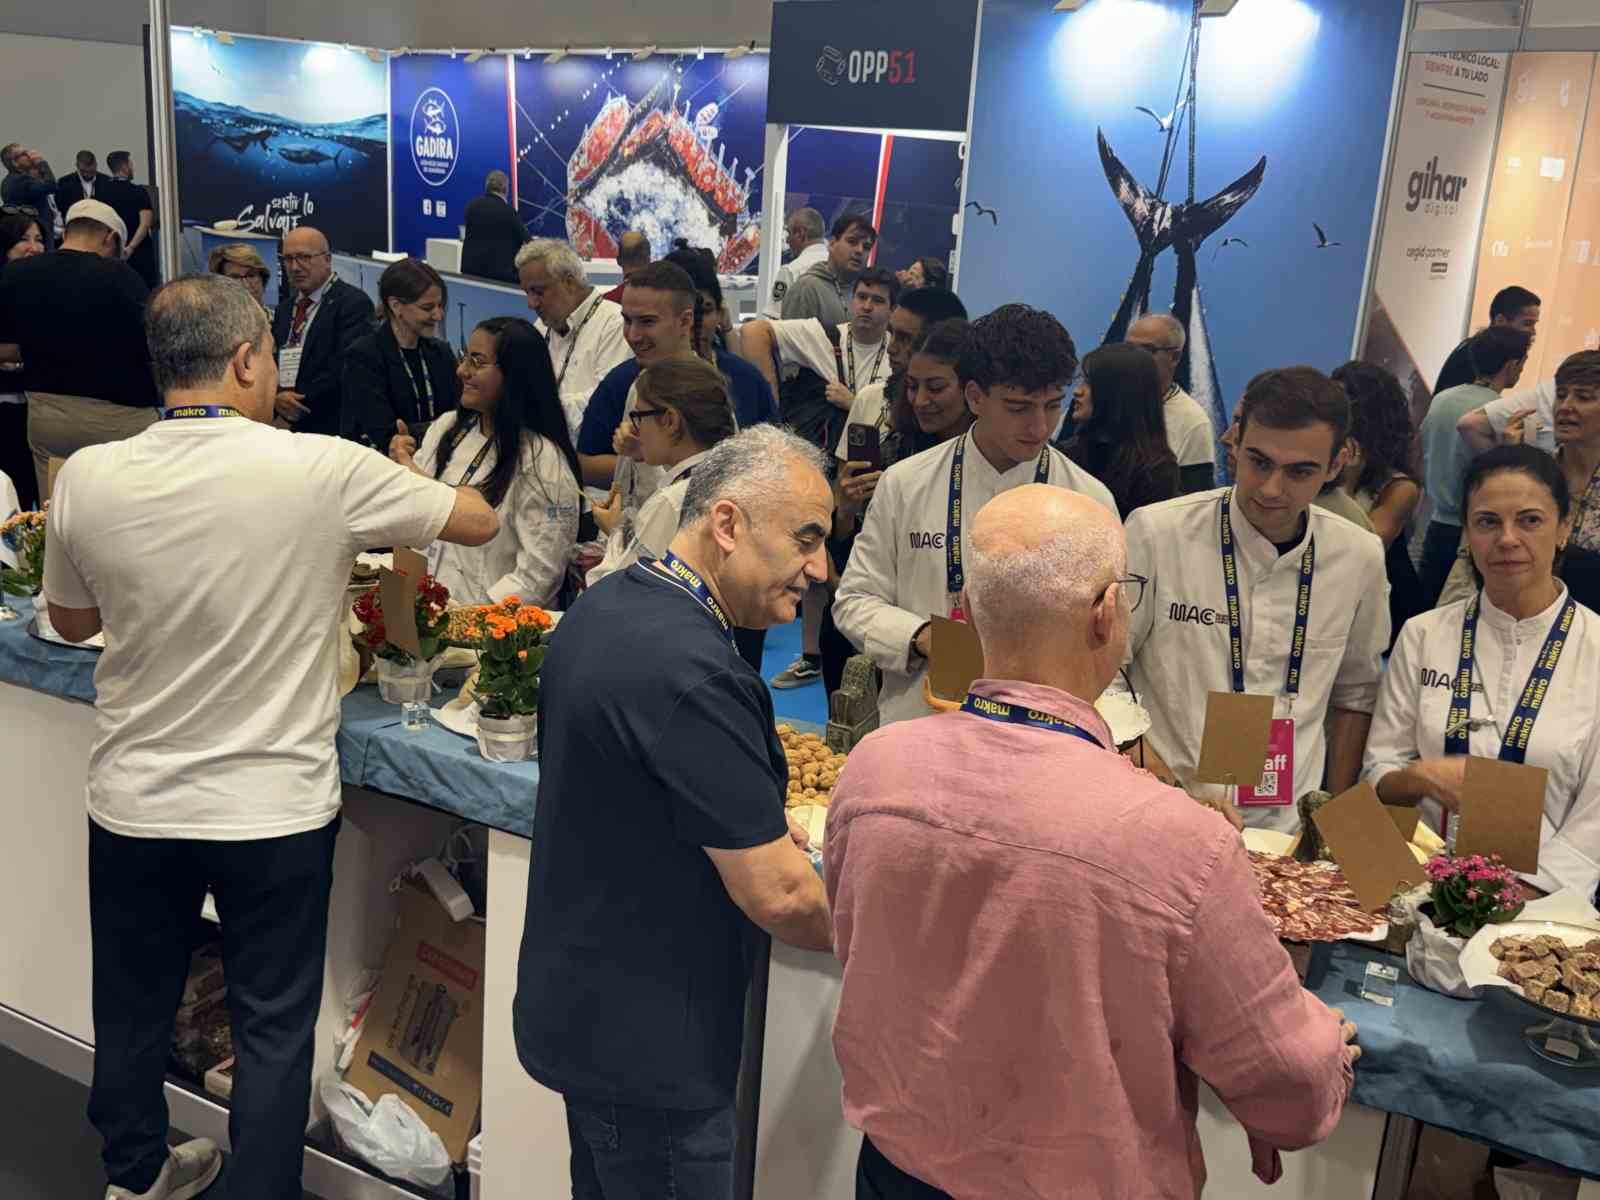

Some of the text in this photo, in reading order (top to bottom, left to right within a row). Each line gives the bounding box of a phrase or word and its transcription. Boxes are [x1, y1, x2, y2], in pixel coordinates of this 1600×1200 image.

[848, 50, 916, 84] OPP51
[416, 136, 454, 160] GADIRA
[1405, 155, 1468, 212] gihar
[303, 192, 314, 216] lo
[174, 407, 207, 417] makro
[952, 499, 961, 527] makro
[952, 536, 961, 564] makro
[670, 559, 702, 588] makro
[1224, 554, 1235, 585] makro
[706, 596, 729, 630] makro
[1229, 595, 1239, 627] makro
[1298, 584, 1309, 616] makro
[1560, 606, 1574, 632] makro
[1232, 637, 1241, 669] makro
[1293, 626, 1304, 657] makro
[1462, 629, 1472, 659] makro
[1545, 640, 1562, 670] makro
[1460, 668, 1470, 698] makro
[1531, 679, 1548, 709] makro
[974, 698, 1010, 716] makro
[1505, 716, 1522, 747] makro
[1516, 718, 1533, 749] makro
[1263, 754, 1288, 771] aff
